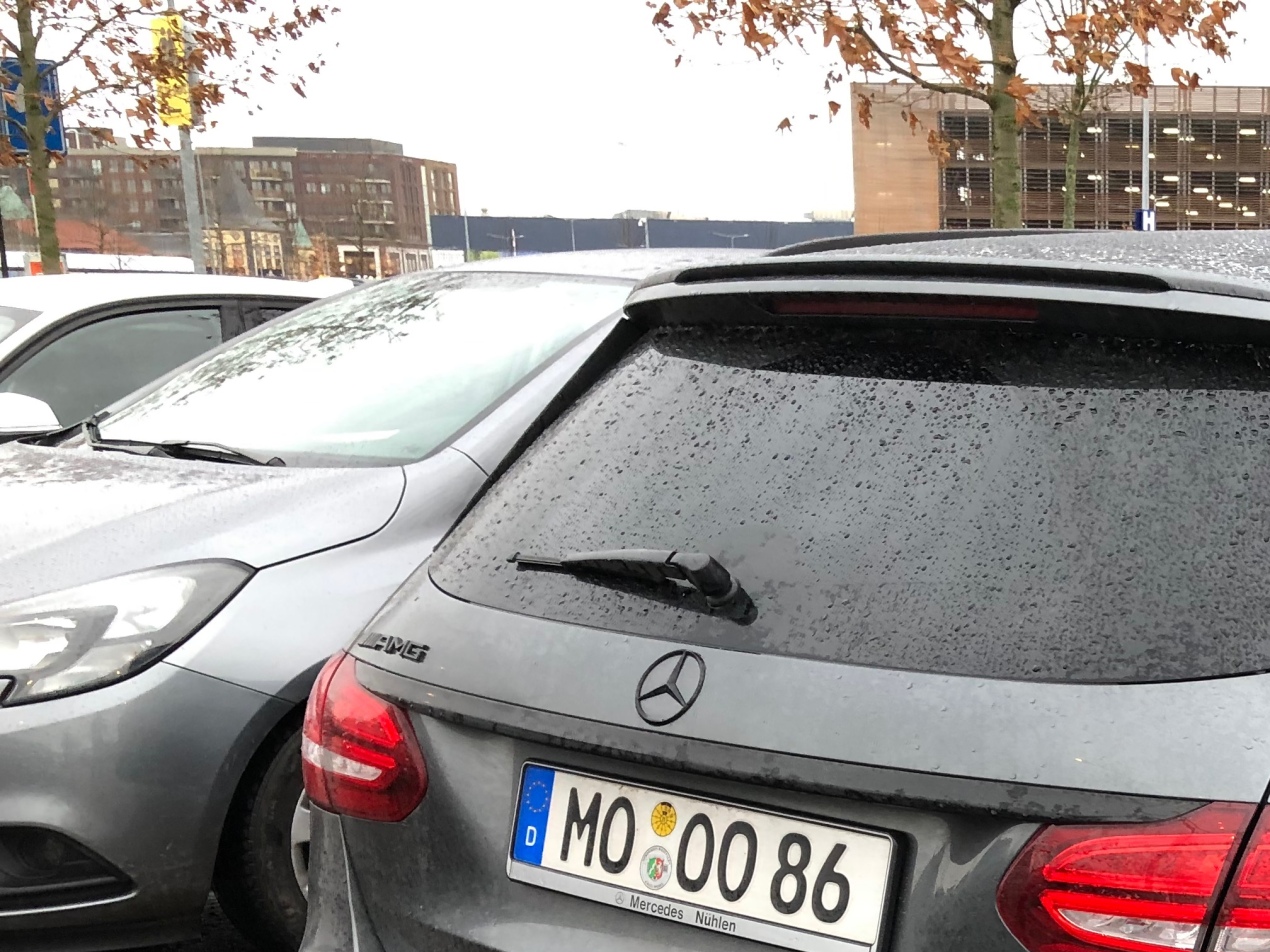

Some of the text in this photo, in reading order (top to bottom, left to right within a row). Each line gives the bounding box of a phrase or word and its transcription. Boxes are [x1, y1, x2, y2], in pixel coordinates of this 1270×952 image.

[1142, 211, 1155, 231] H
[358, 632, 430, 663] AMG
[525, 826, 537, 846] D
[560, 787, 636, 874] MO
[770, 832, 850, 924] 86
[630, 895, 736, 932] Mercedes Nühlen
